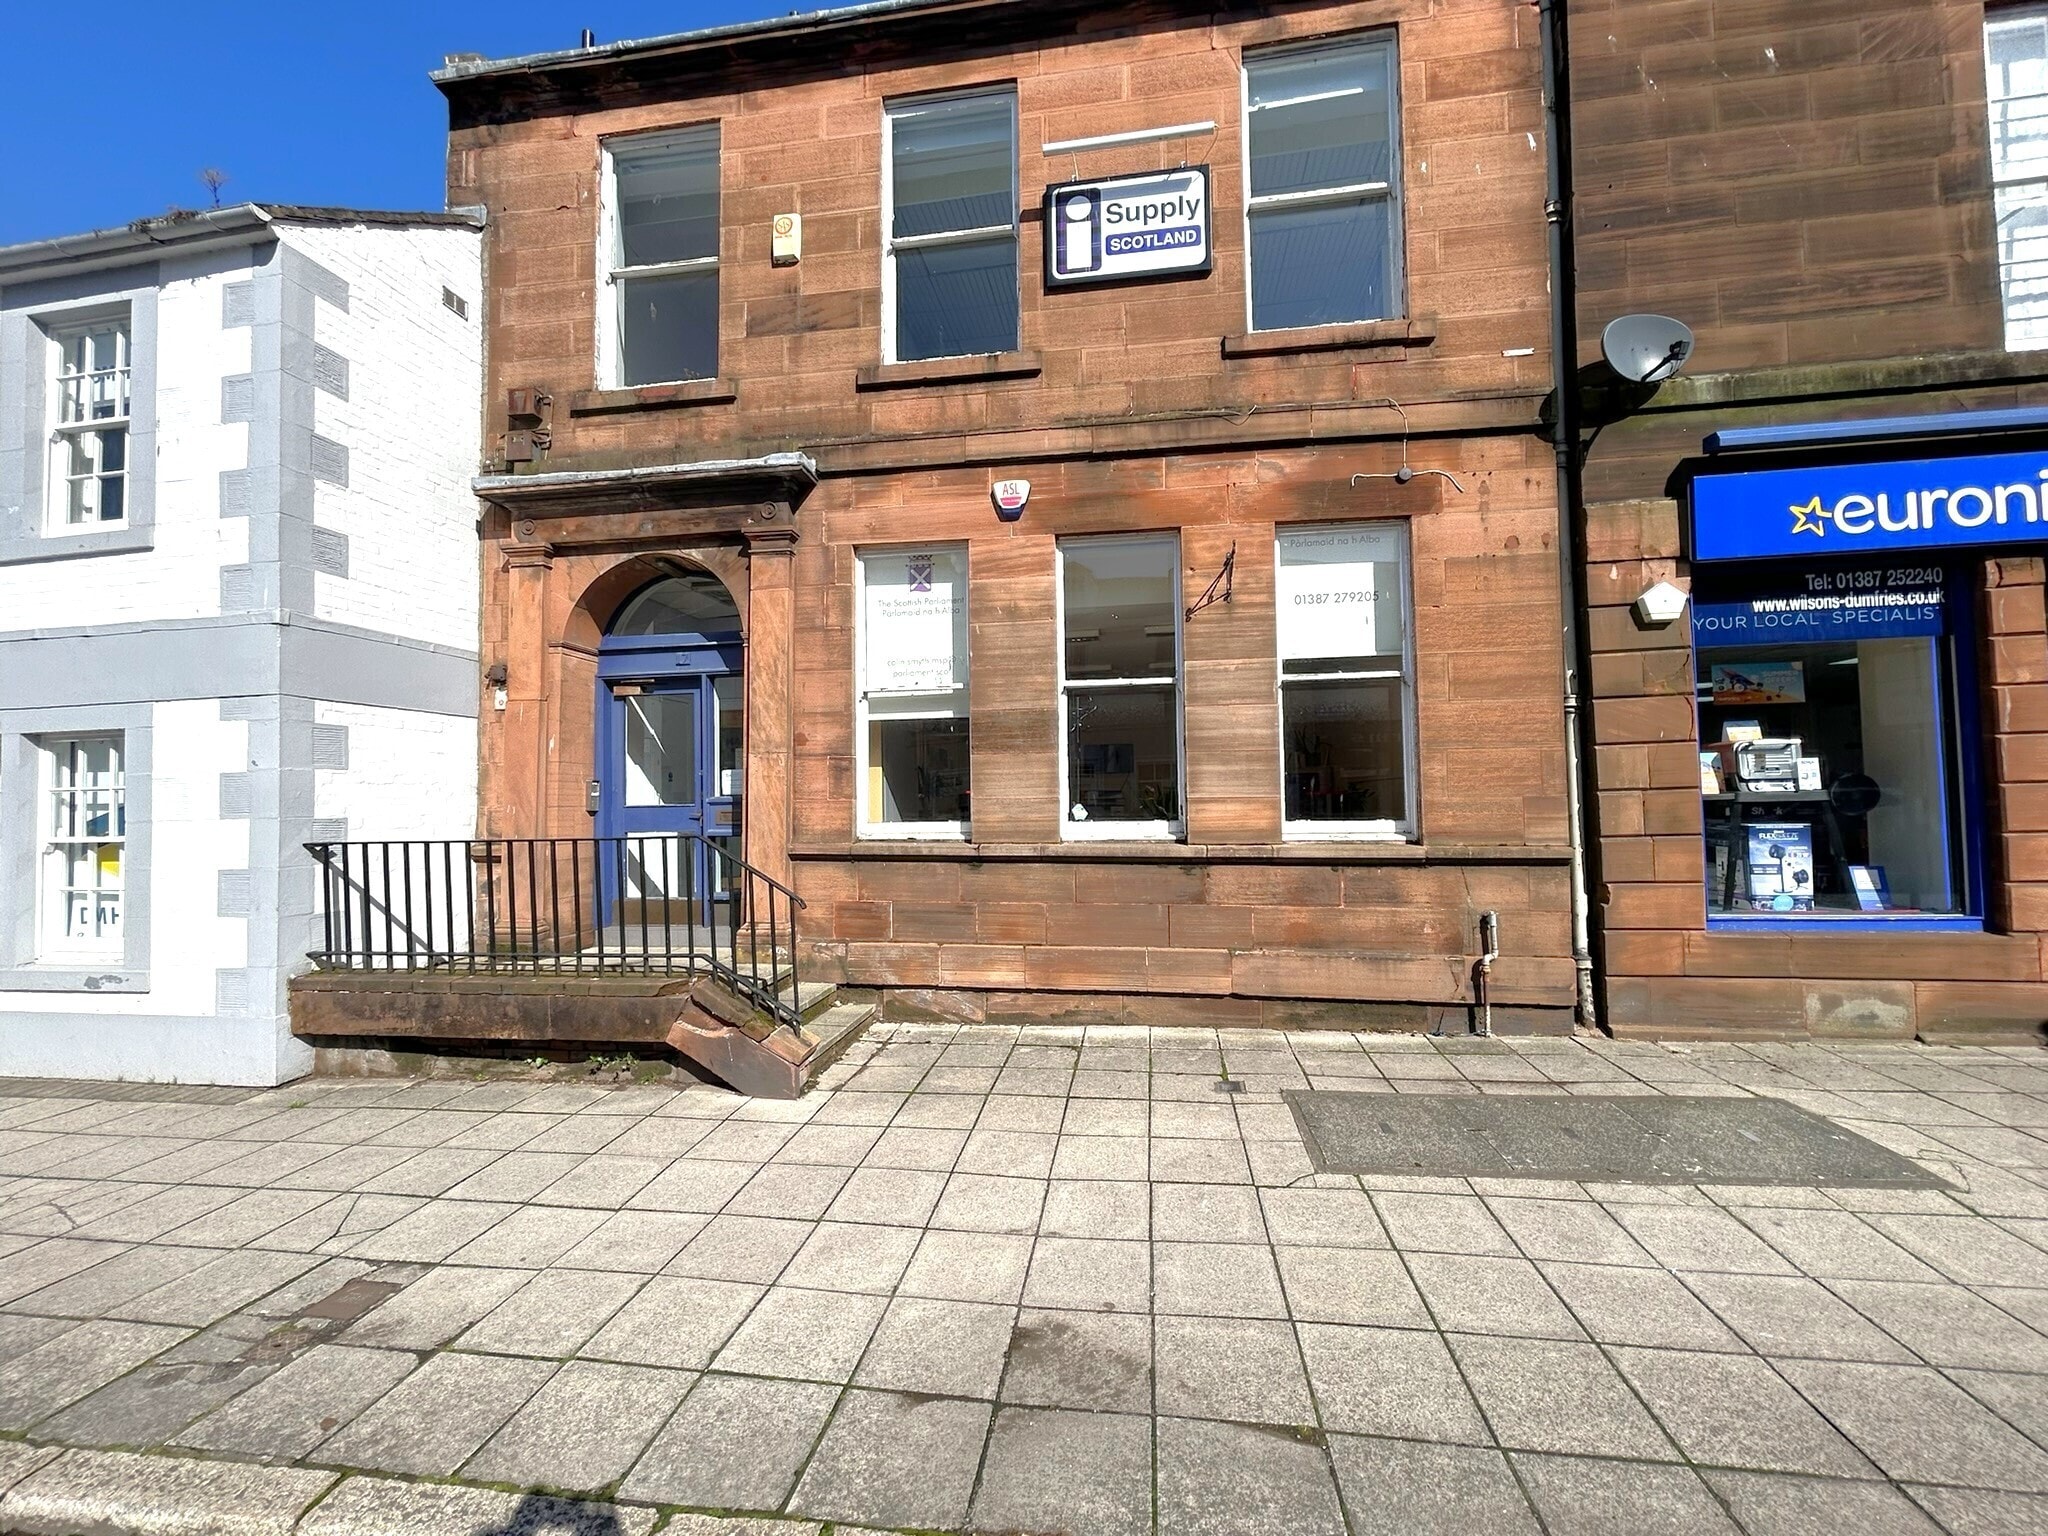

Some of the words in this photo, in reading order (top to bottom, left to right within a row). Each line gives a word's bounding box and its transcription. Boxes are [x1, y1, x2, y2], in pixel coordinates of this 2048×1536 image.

[1106, 195, 1200, 225] Supply
[1110, 230, 1197, 251] SCOTLAND
[1003, 482, 1020, 496] ASL
[1833, 469, 2048, 534] euroni
[1805, 573, 1832, 590] Tel:
[1836, 570, 1882, 589] 01387
[1887, 567, 1943, 586] 252240
[878, 599, 892, 608] The
[893, 598, 922, 608] Scottish
[924, 596, 964, 606] Parliament
[1294, 593, 1330, 606] 01387
[1334, 590, 1380, 604] 279205
[1752, 587, 1945, 613] www.wilsons-dumfries.co.uk
[1693, 616, 1747, 630] YOUR
[1754, 612, 1819, 628] LOCAL
[1833, 606, 1939, 624] SPECIALIS
[1751, 806, 1783, 816] Shk
